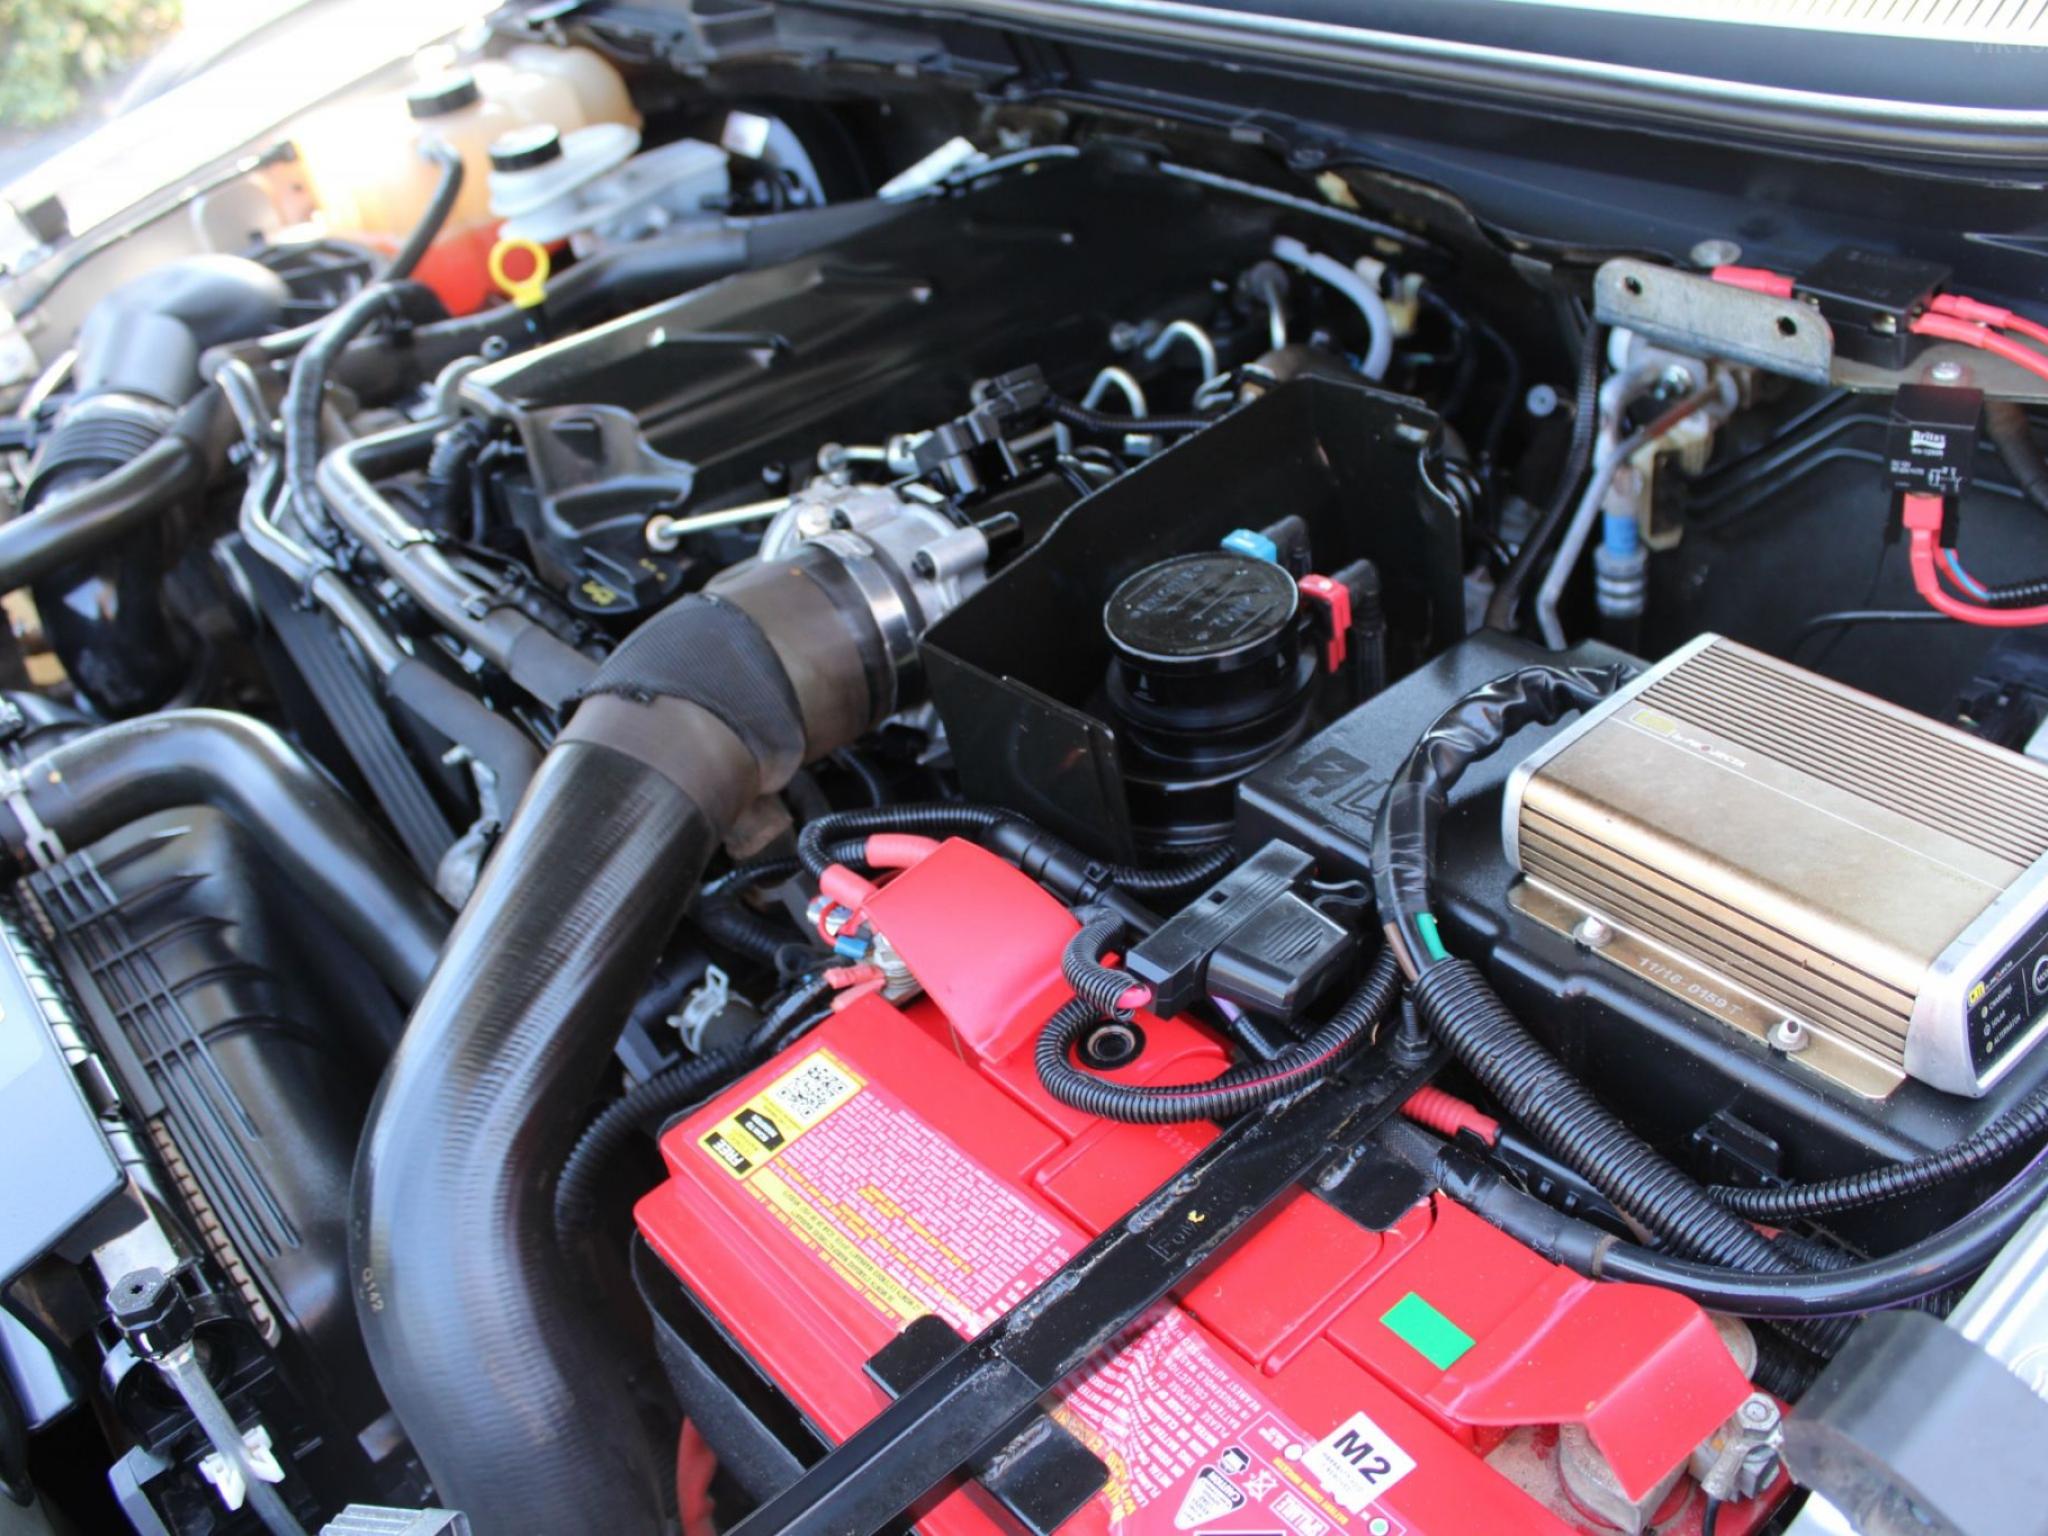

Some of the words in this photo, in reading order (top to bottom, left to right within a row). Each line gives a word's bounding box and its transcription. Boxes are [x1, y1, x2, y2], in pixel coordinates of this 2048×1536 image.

[711, 1137, 745, 1167] FREE
[1166, 1379, 1201, 1412] DISPOSE
[1194, 1370, 1242, 1413] HOUSEHOLD
[1225, 1379, 1262, 1413] NEAREST
[1199, 1410, 1231, 1439] PLEASE
[1204, 1396, 1242, 1431] BATTERY
[1333, 1429, 1391, 1485] M2
[1207, 1469, 1242, 1503] CAUTION
